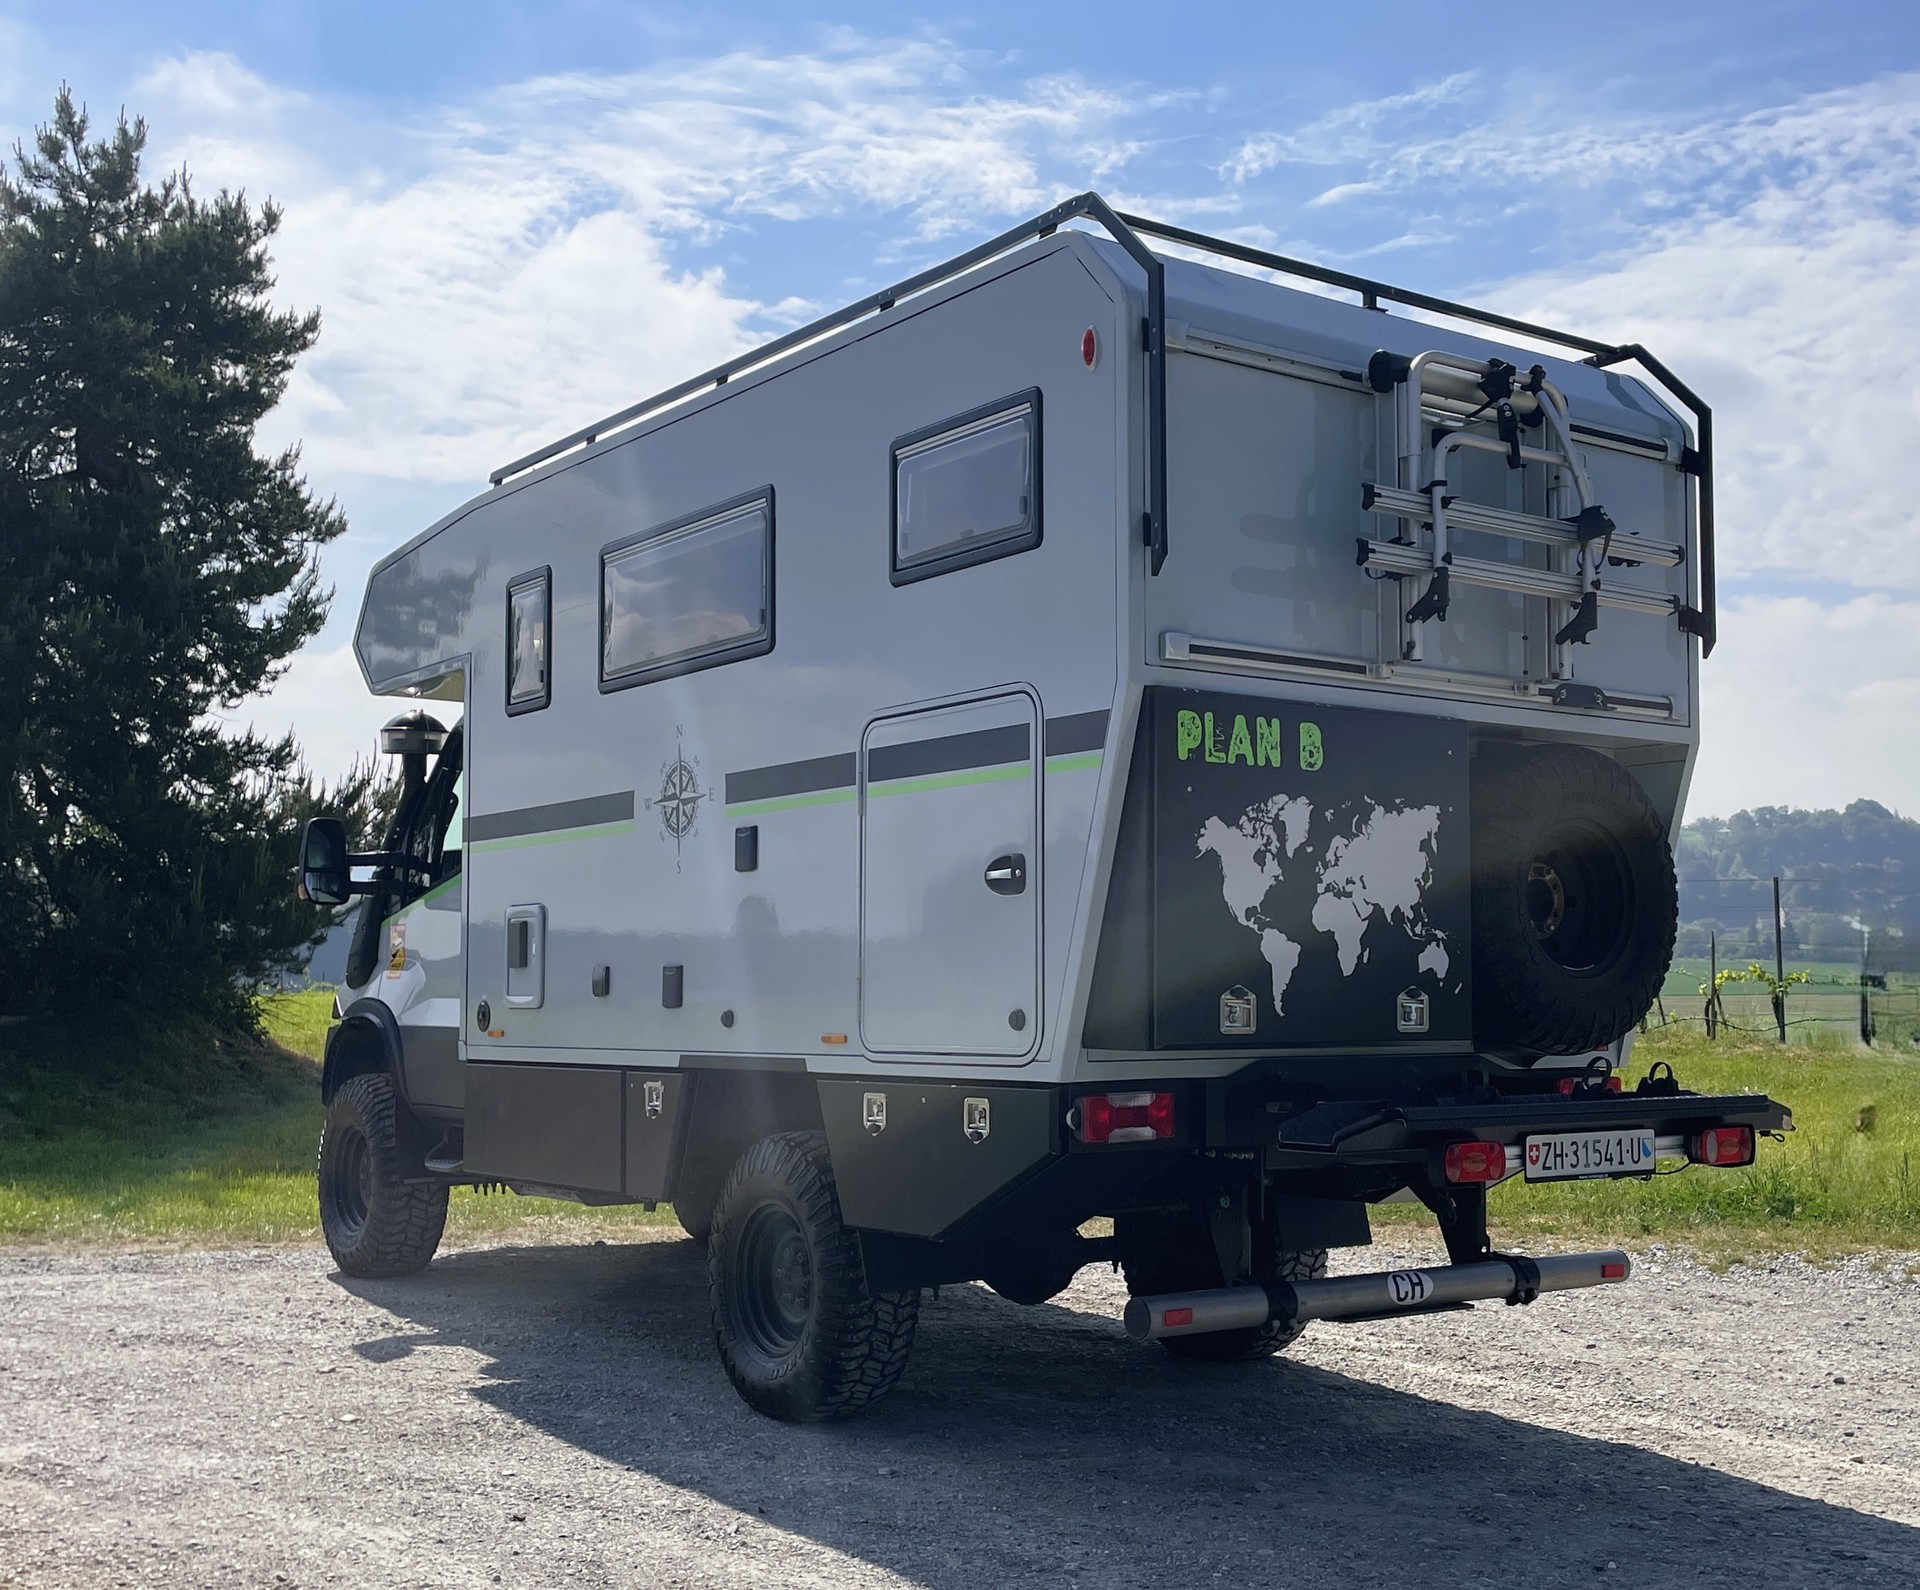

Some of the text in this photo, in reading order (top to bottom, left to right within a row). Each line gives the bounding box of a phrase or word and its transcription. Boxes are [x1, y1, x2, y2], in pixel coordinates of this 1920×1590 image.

[675, 723, 683, 739] N
[1177, 709, 1324, 771] PLAN B
[708, 787, 715, 802] E
[644, 797, 653, 811] W
[676, 860, 682, 874] S
[1391, 1272, 1425, 1302] CH
